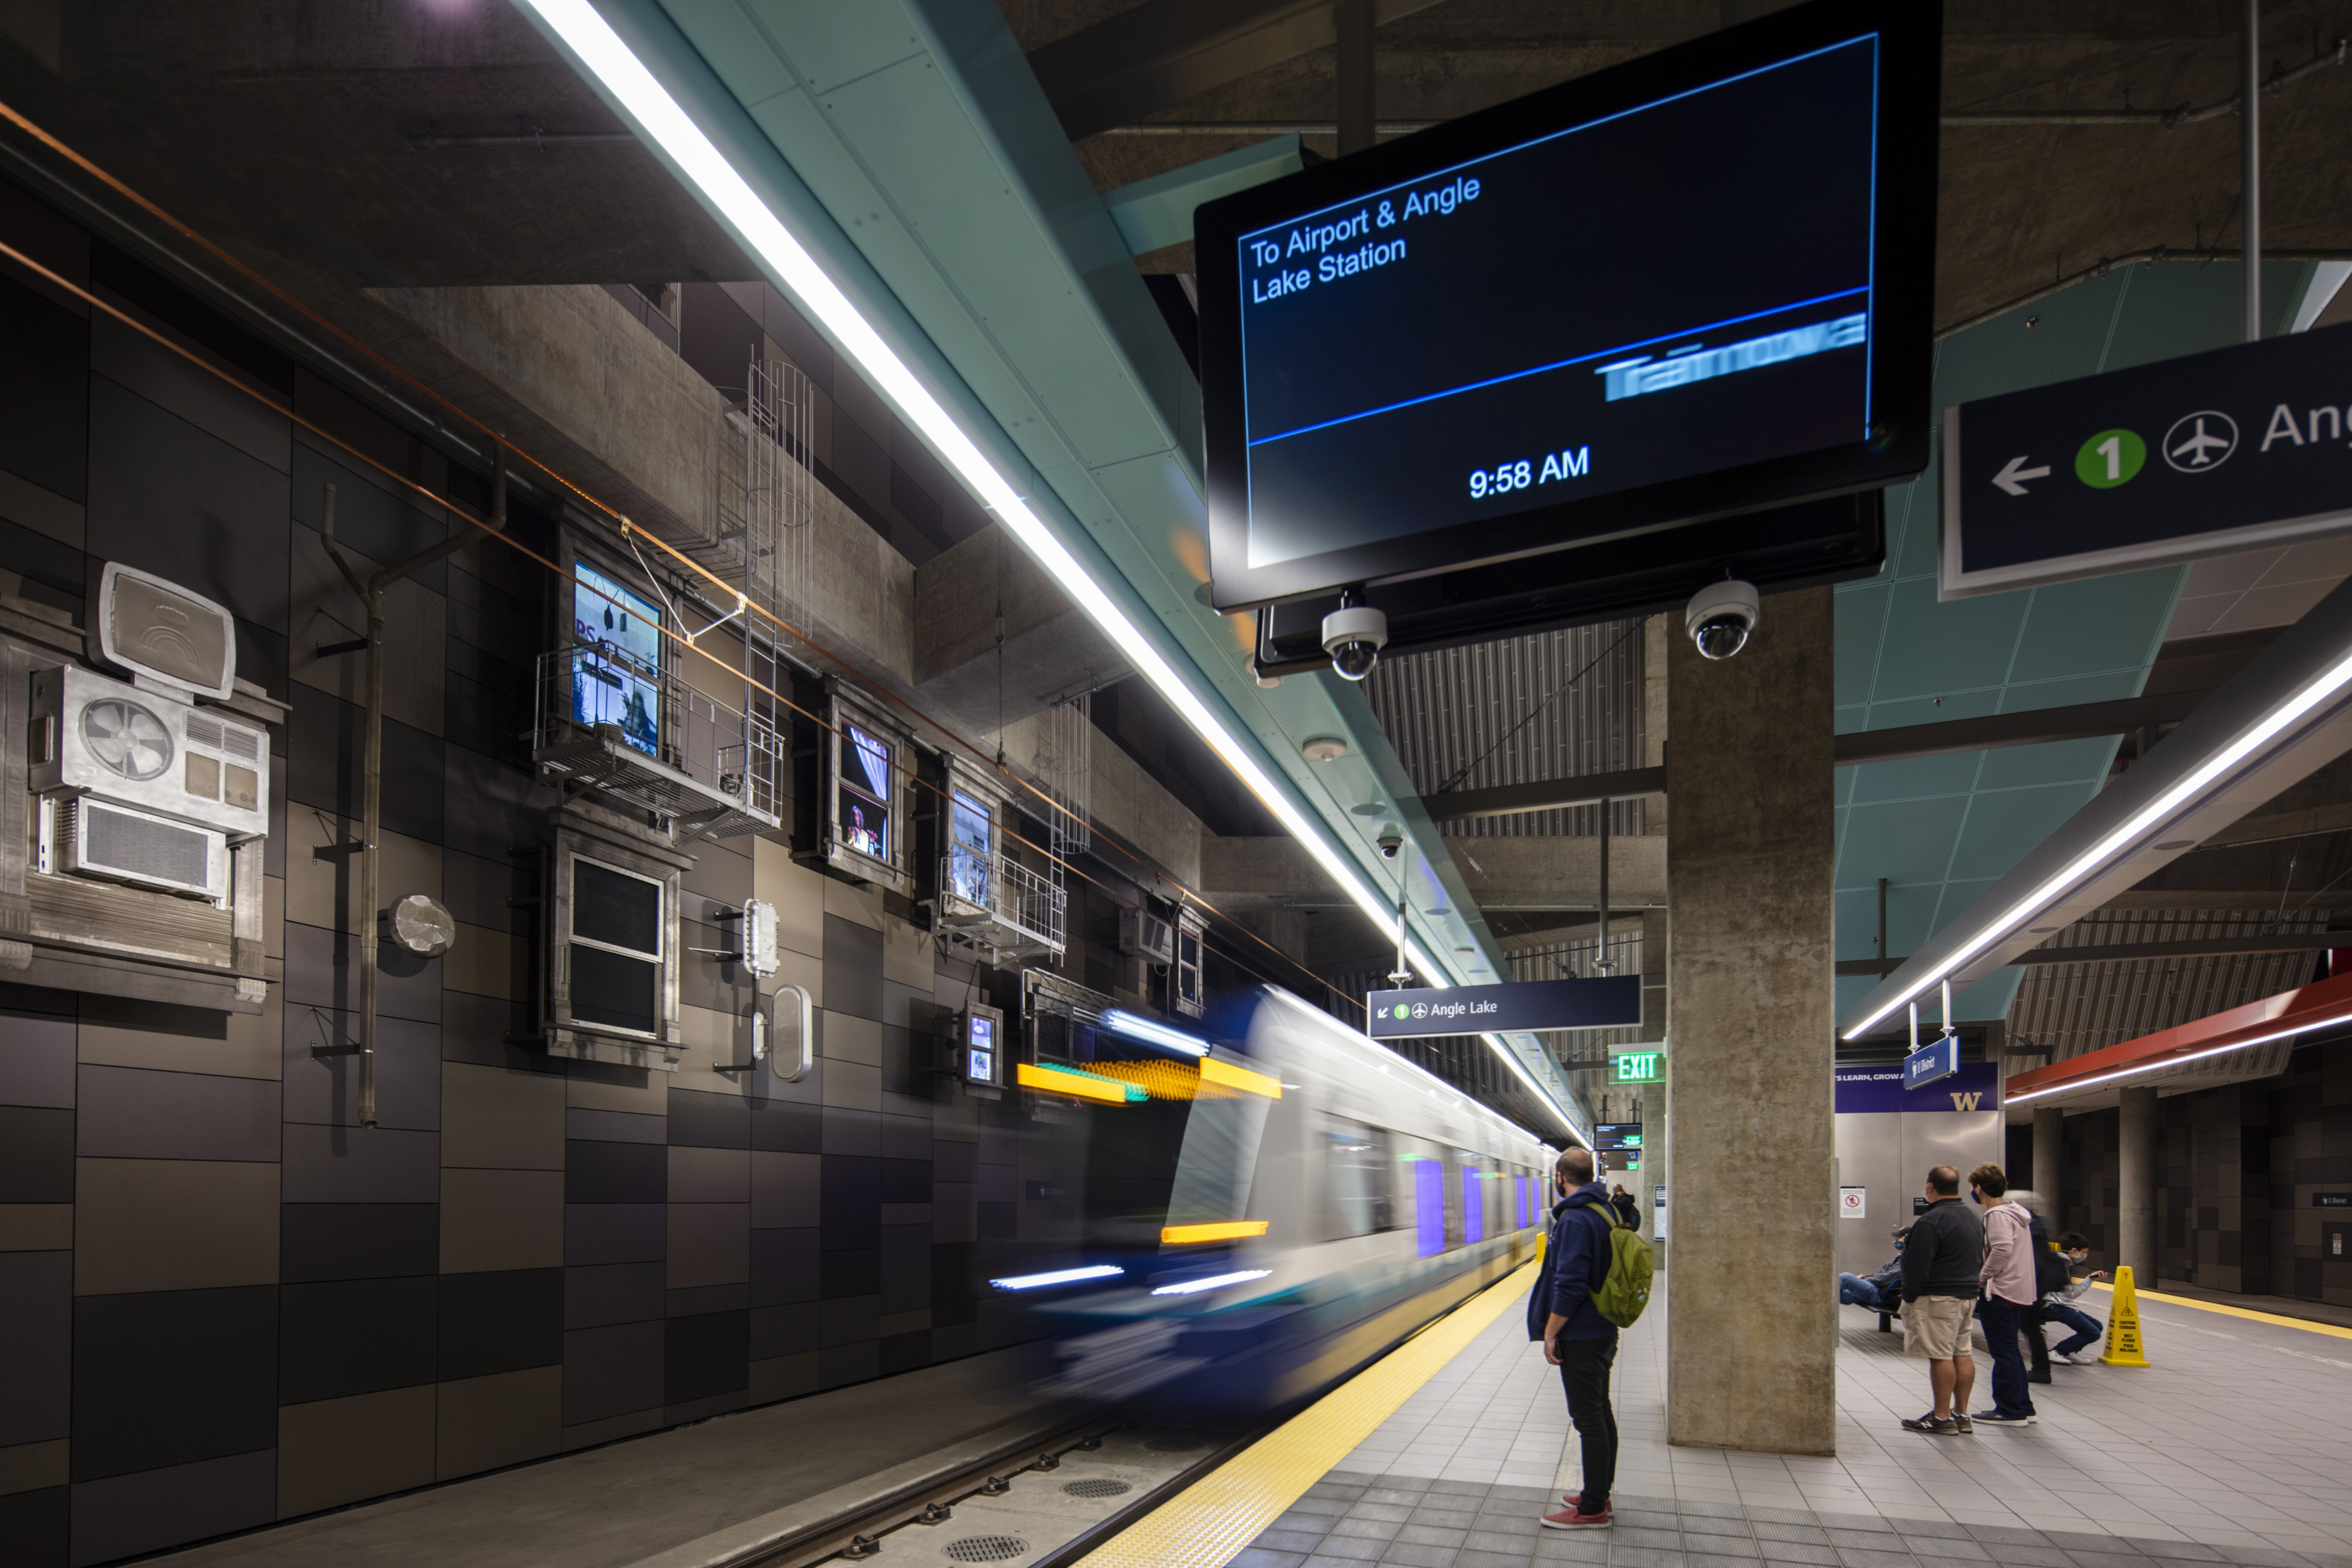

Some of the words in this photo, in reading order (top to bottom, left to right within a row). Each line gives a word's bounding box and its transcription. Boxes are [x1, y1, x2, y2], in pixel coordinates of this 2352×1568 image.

[1250, 239, 1280, 268] To
[1286, 207, 1370, 259] Airport
[1376, 199, 1396, 228] &
[1402, 175, 1481, 221] Angle
[1252, 268, 1311, 304] Lake
[1319, 238, 1407, 283] Station
[1469, 458, 1532, 499] 9:58
[1539, 444, 1590, 485] AM
[2096, 435, 2120, 480] 1
[1398, 1006, 1405, 1018] 1
[1430, 1001, 1466, 1018] Angle
[1470, 1000, 1498, 1014] Lake
[1618, 1053, 1658, 1080] EXIT
[1917, 1061, 1921, 1073] U
[1922, 1056, 1935, 1072] District
[1949, 1092, 1983, 1112] W
